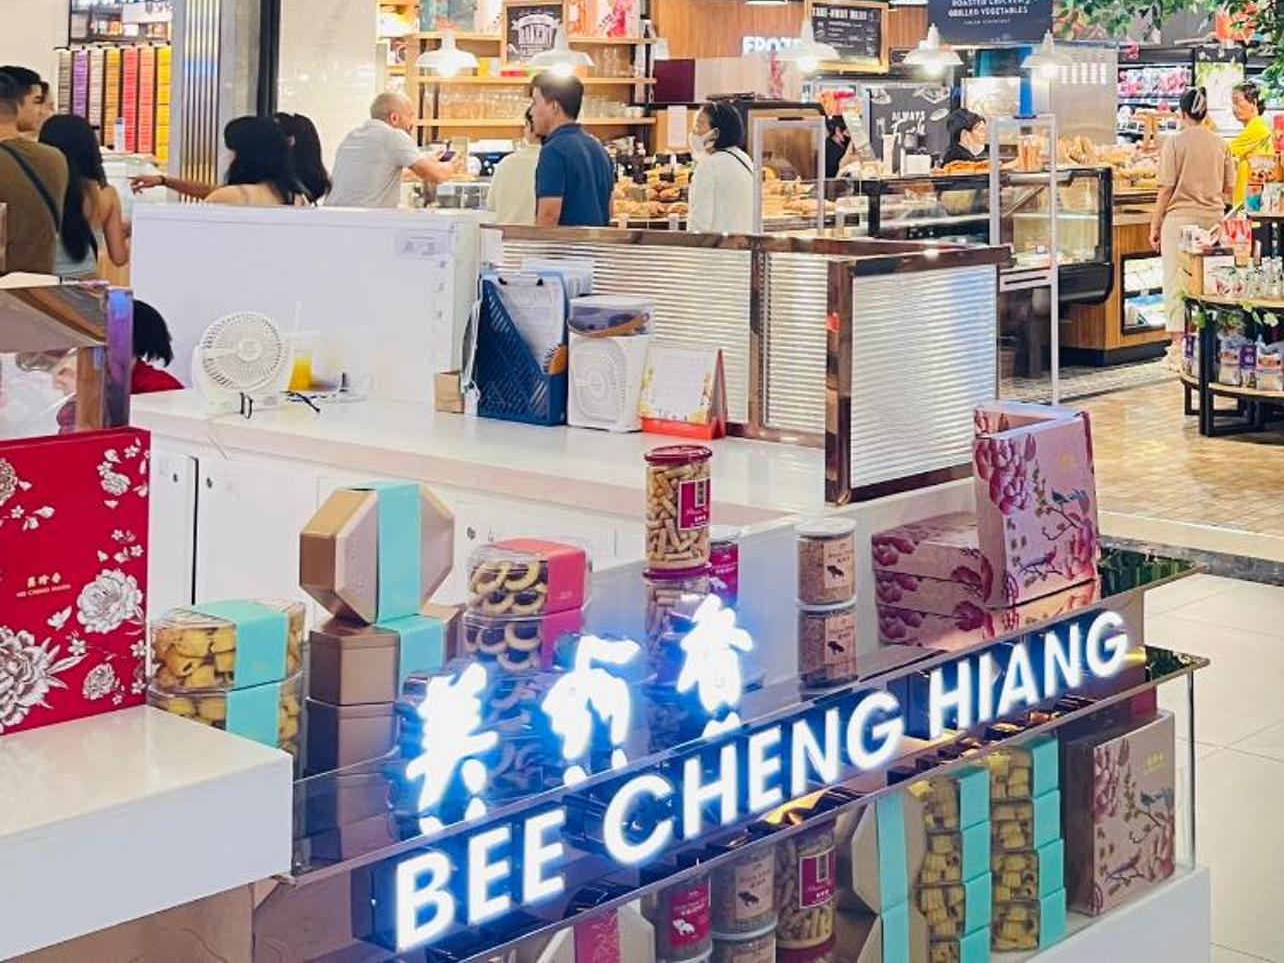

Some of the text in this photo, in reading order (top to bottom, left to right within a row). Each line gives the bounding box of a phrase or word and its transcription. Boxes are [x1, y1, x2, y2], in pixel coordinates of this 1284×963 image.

[395, 610, 1129, 952] BEE CHENG HIANG
